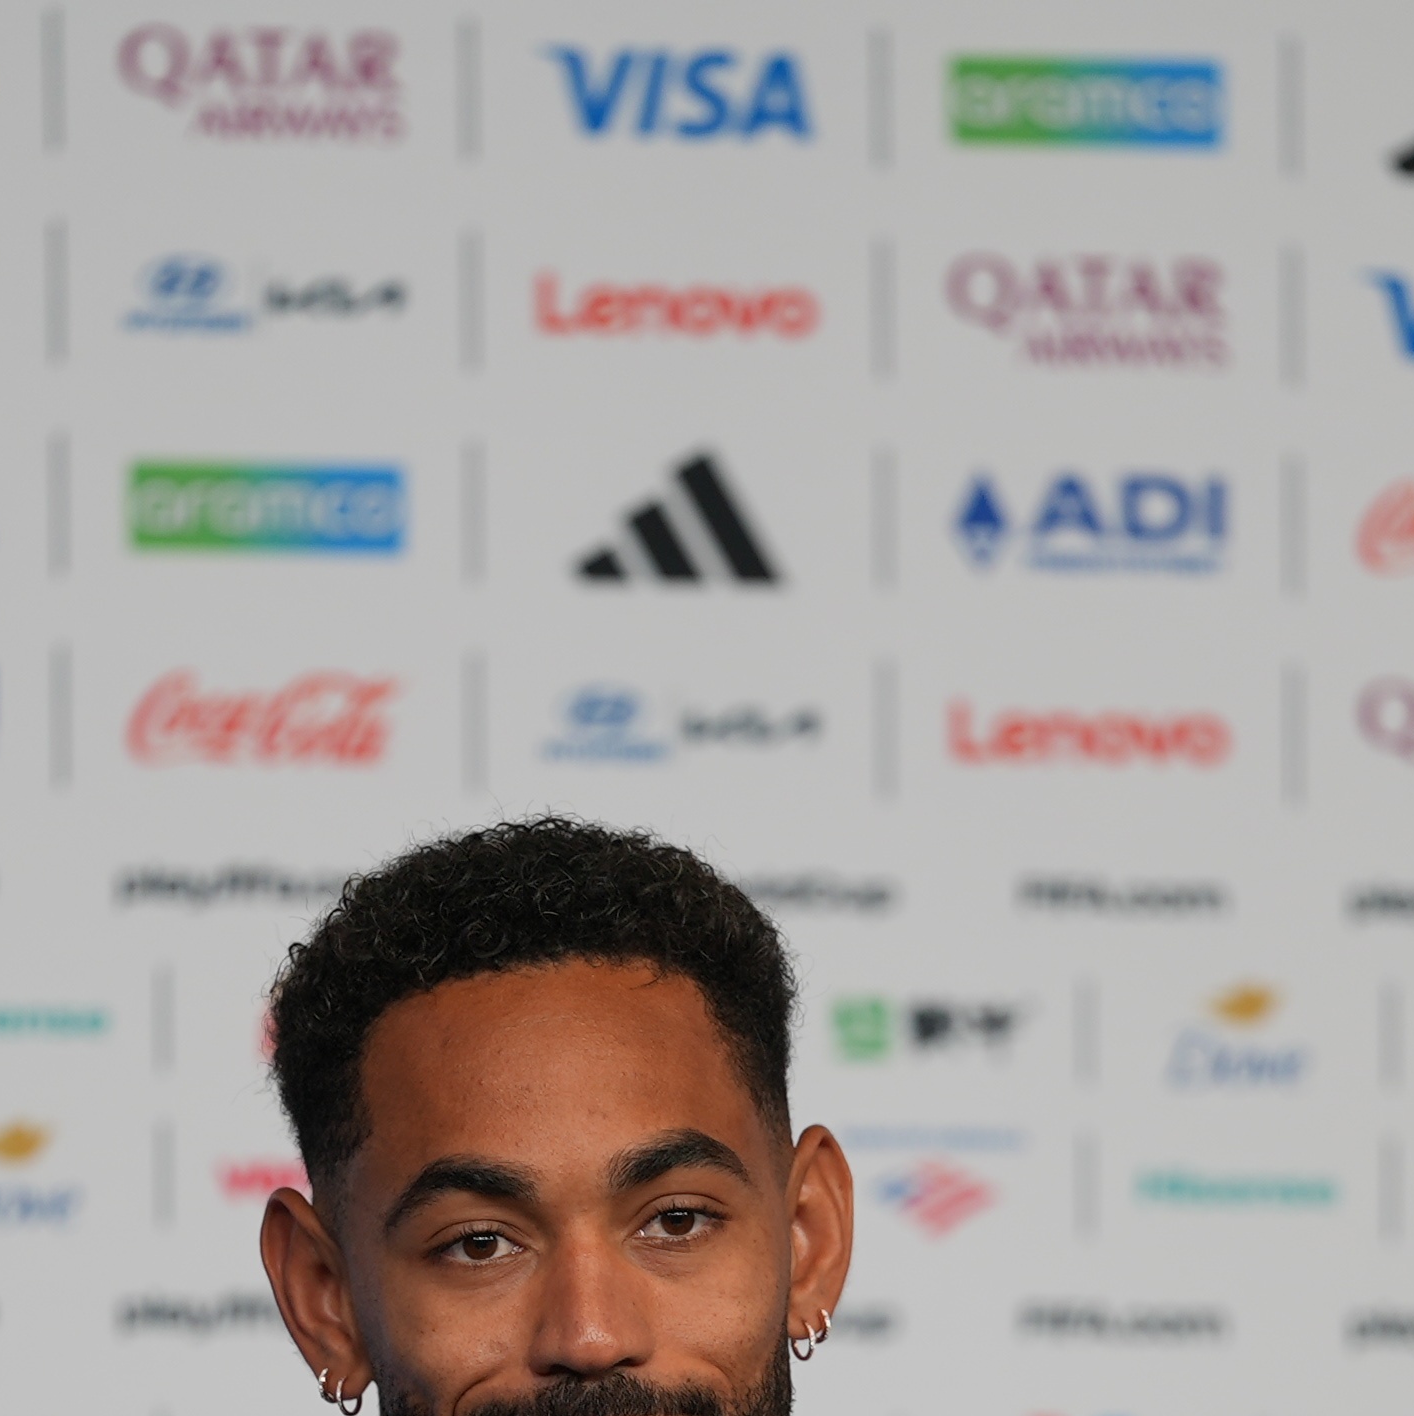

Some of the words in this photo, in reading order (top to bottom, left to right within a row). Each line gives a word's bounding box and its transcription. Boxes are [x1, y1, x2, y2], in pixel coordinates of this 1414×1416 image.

[116, 24, 403, 105] QATAR
[551, 46, 813, 142] VISA
[535, 276, 819, 339] Lenovo
[945, 255, 1226, 332] QATAR
[1029, 472, 1229, 540] ADI
[948, 705, 1231, 767] Lenovo
